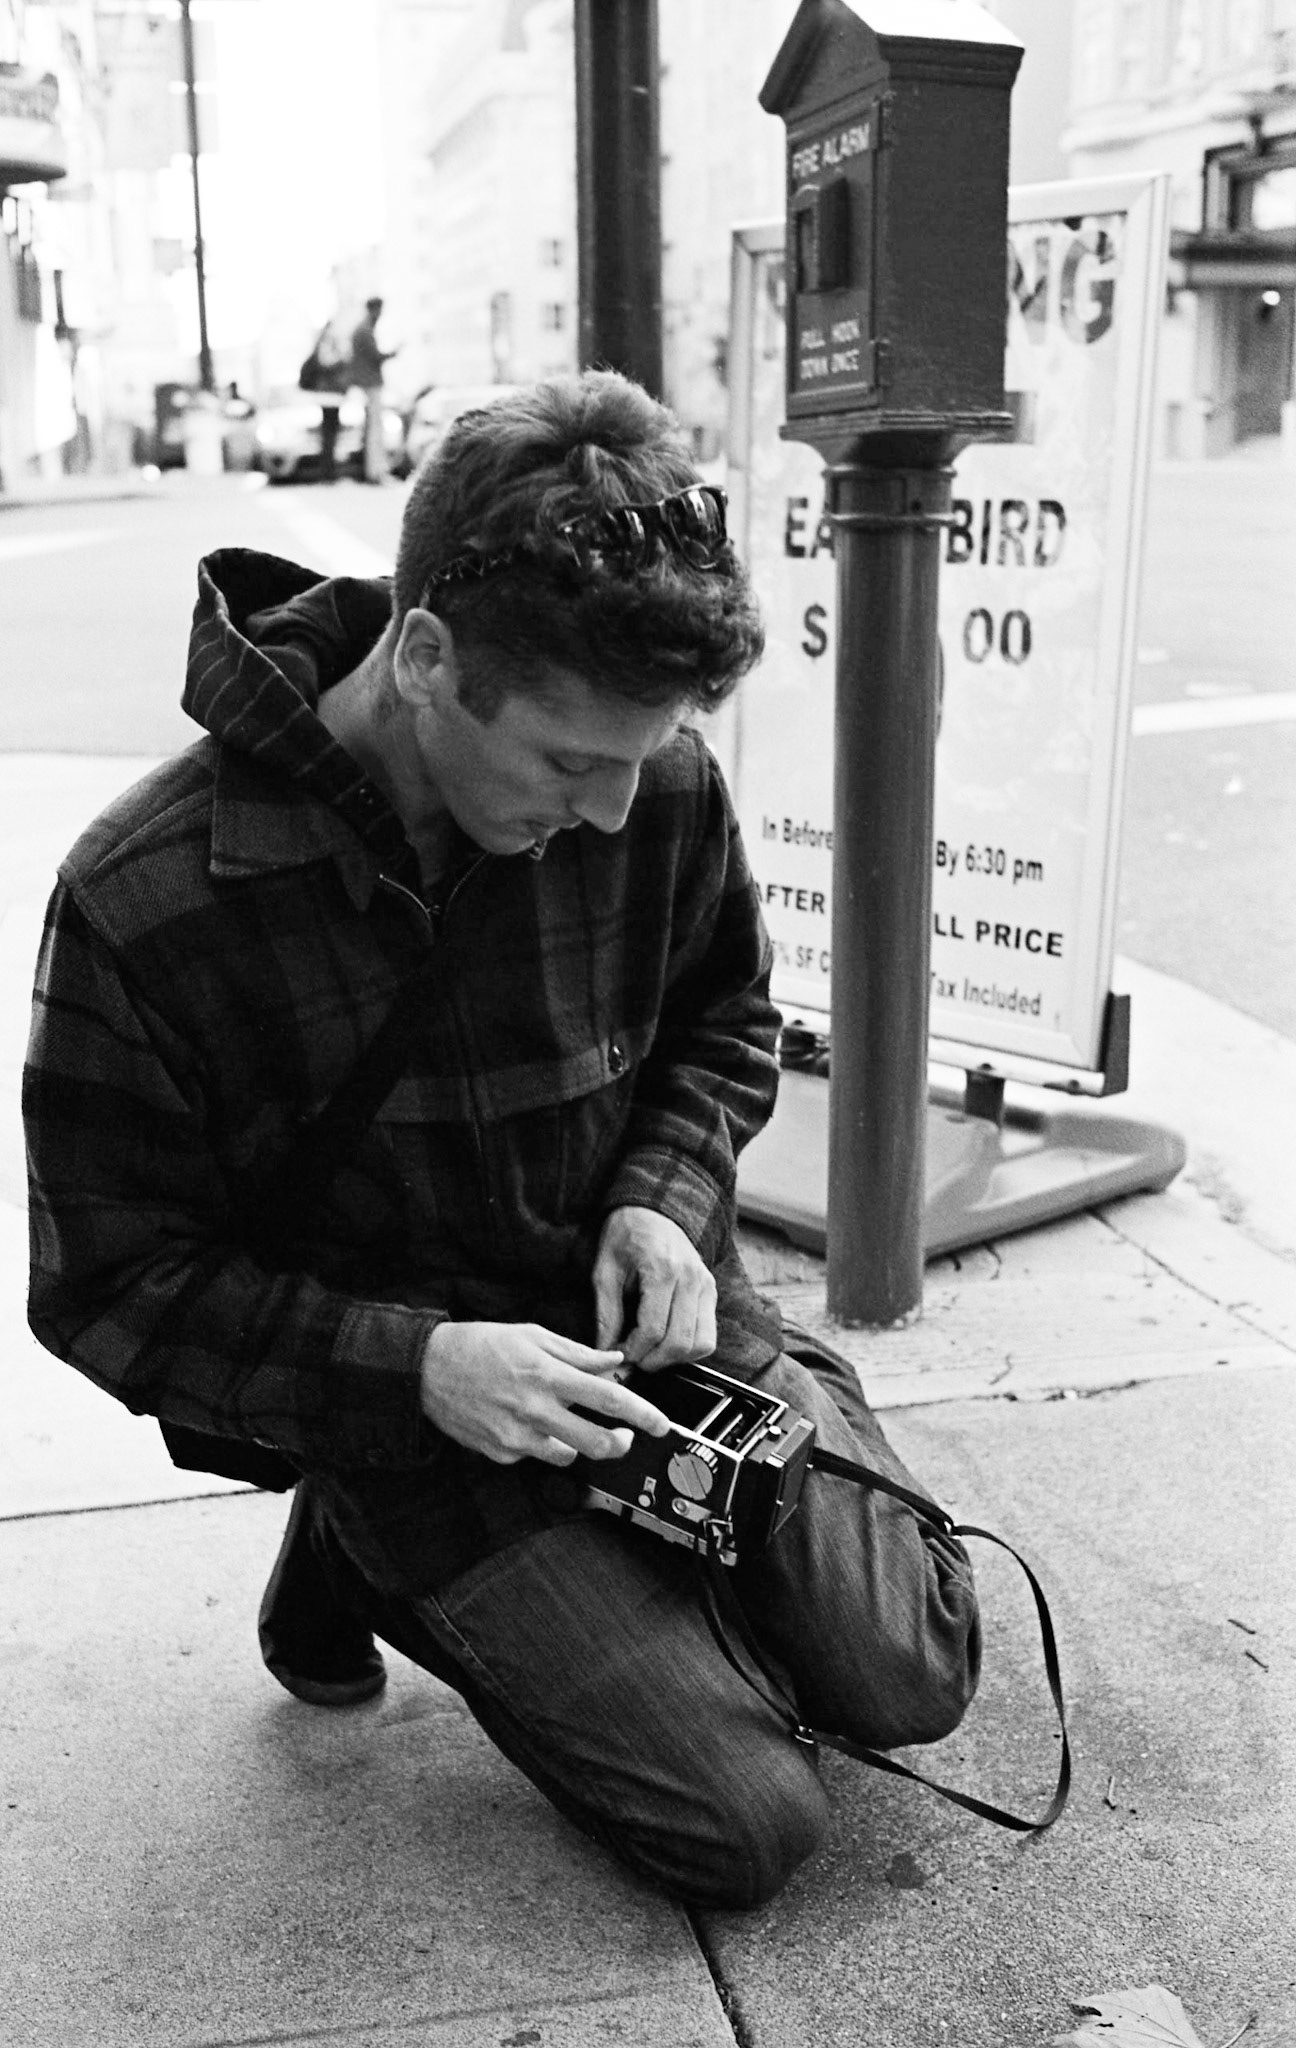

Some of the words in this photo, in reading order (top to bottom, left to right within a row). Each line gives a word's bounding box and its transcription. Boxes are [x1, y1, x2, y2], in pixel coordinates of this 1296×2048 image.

[793, 143, 820, 178] FIRE
[822, 122, 869, 166] ALARM
[946, 499, 1066, 567] BIRD
[784, 818, 833, 850] Before
[936, 840, 957, 876] By
[965, 845, 1006, 876] 6:30
[1012, 858, 1043, 885] pm
[976, 920, 1063, 957] PRICE
[964, 977, 1042, 1016] Included
